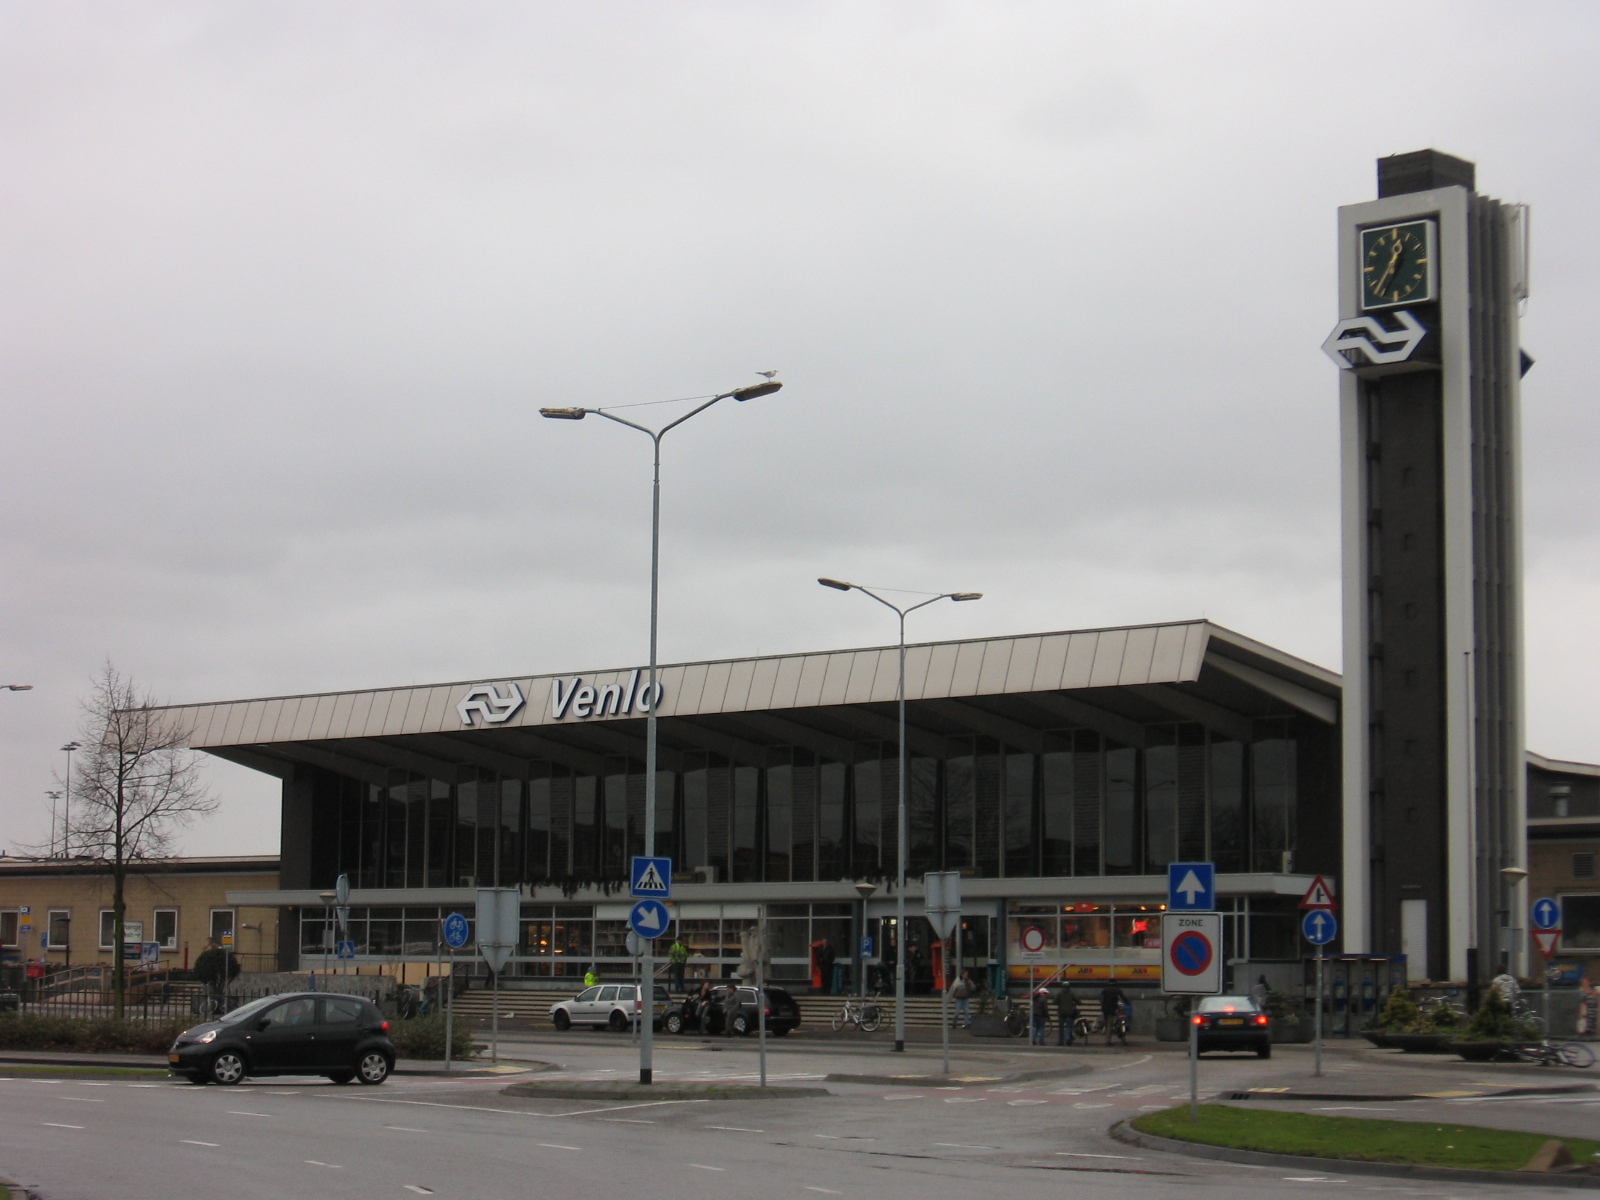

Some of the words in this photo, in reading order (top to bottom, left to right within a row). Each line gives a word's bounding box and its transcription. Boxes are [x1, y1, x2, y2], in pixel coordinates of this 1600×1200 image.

[552, 669, 662, 719] Venlo
[1179, 919, 1204, 927] ZONE
[863, 939, 870, 949] P
